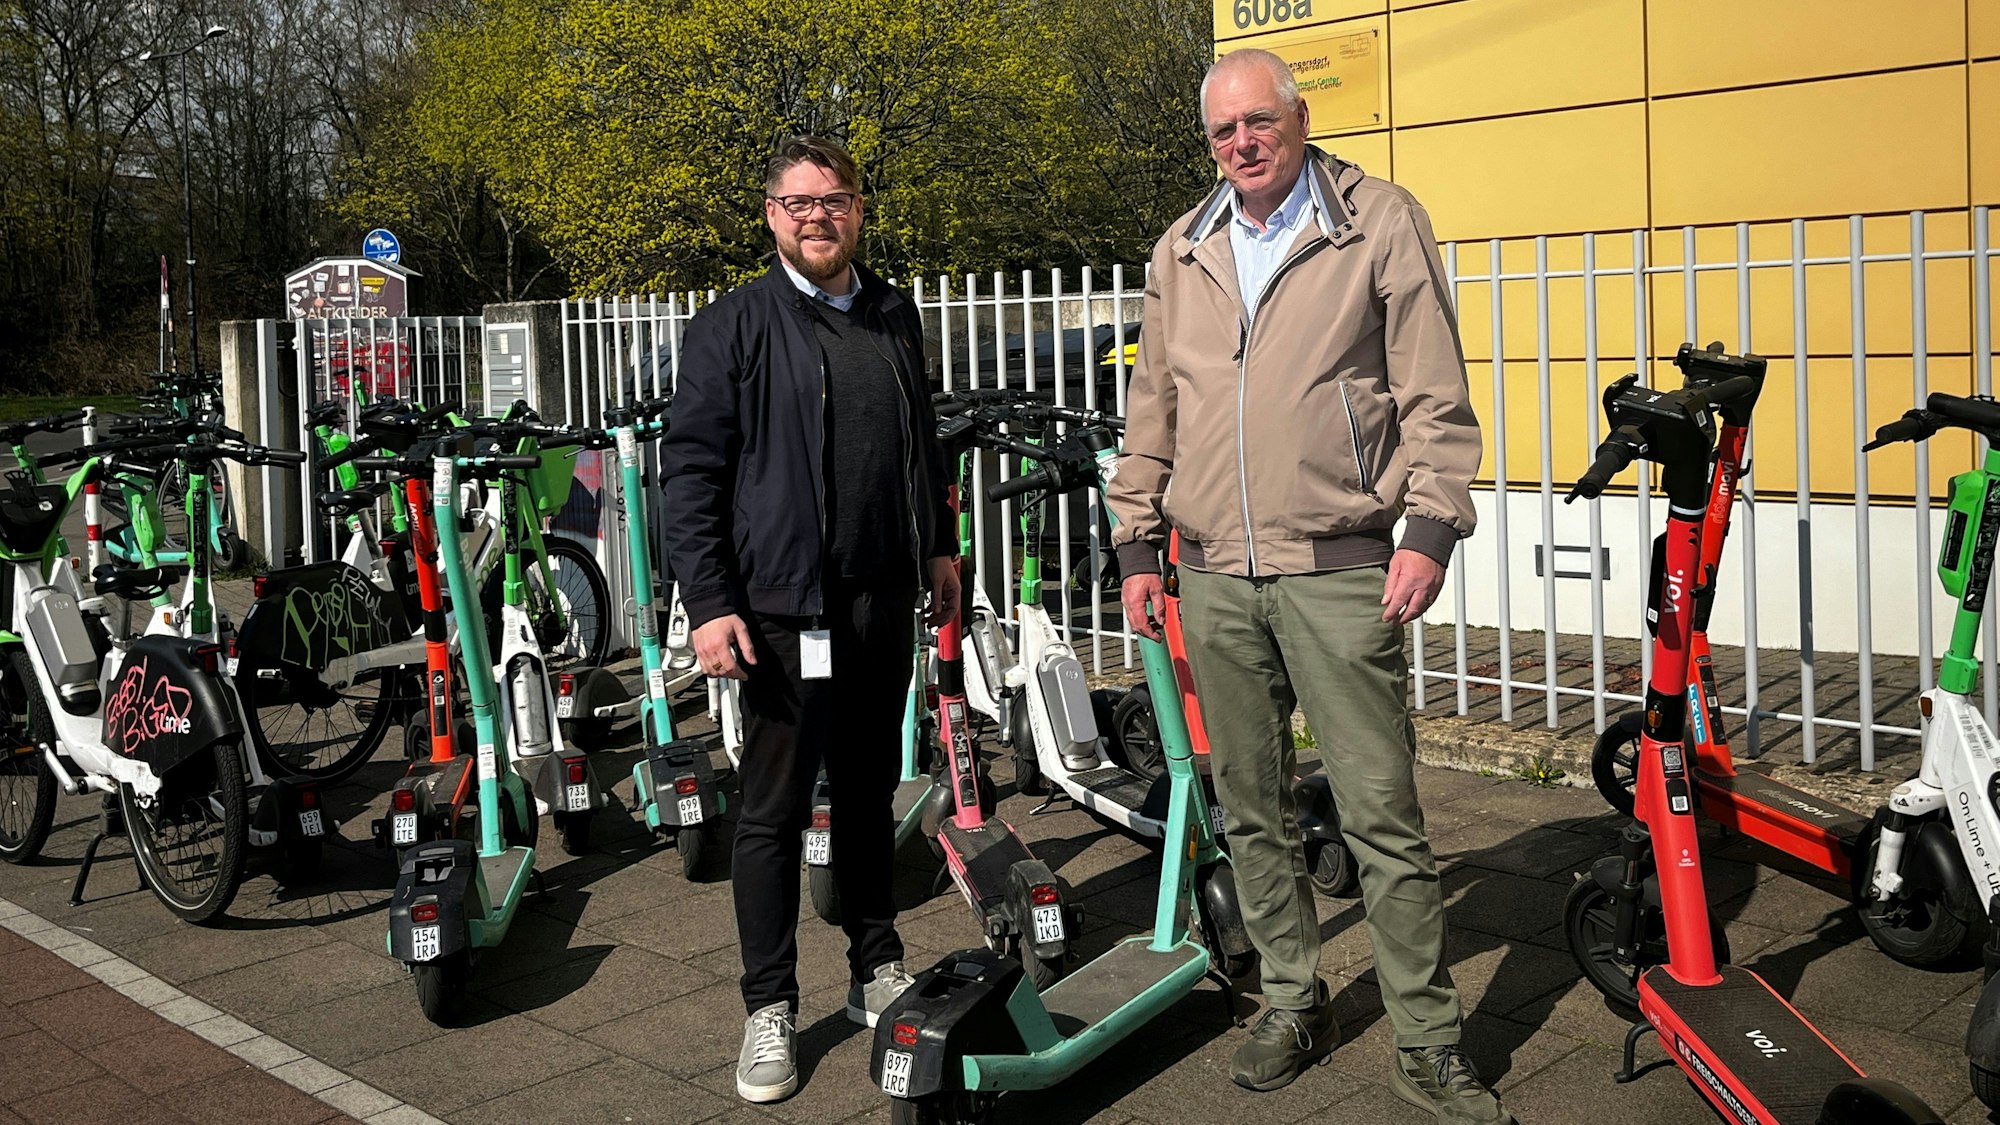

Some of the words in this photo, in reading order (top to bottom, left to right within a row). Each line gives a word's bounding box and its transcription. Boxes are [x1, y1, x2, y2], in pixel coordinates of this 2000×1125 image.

[1664, 569, 1684, 614] voi.
[1688, 684, 1703, 743] FREI
[569, 786, 586, 797] 733
[571, 797, 587, 809] IEM
[680, 798, 699, 812] 699
[302, 811, 318, 824] 659
[683, 810, 702, 824] IRE
[1211, 807, 1223, 819] 16
[396, 817, 414, 829] 270
[1214, 820, 1225, 832] IE
[1958, 791, 1970, 817] On
[1966, 817, 1985, 858] Lime
[396, 829, 414, 841] ITE
[808, 836, 827, 848] 495
[808, 849, 826, 861] IRC
[1037, 909, 1058, 924] 473
[414, 929, 437, 943] 154
[1040, 924, 1060, 940] IKD
[416, 943, 437, 959] IRA
[1745, 1029, 1787, 1058] voi.
[887, 1054, 909, 1073] 897
[884, 1073, 905, 1093] IRC
[1692, 1053, 1757, 1125] FREISCHALTGEB
